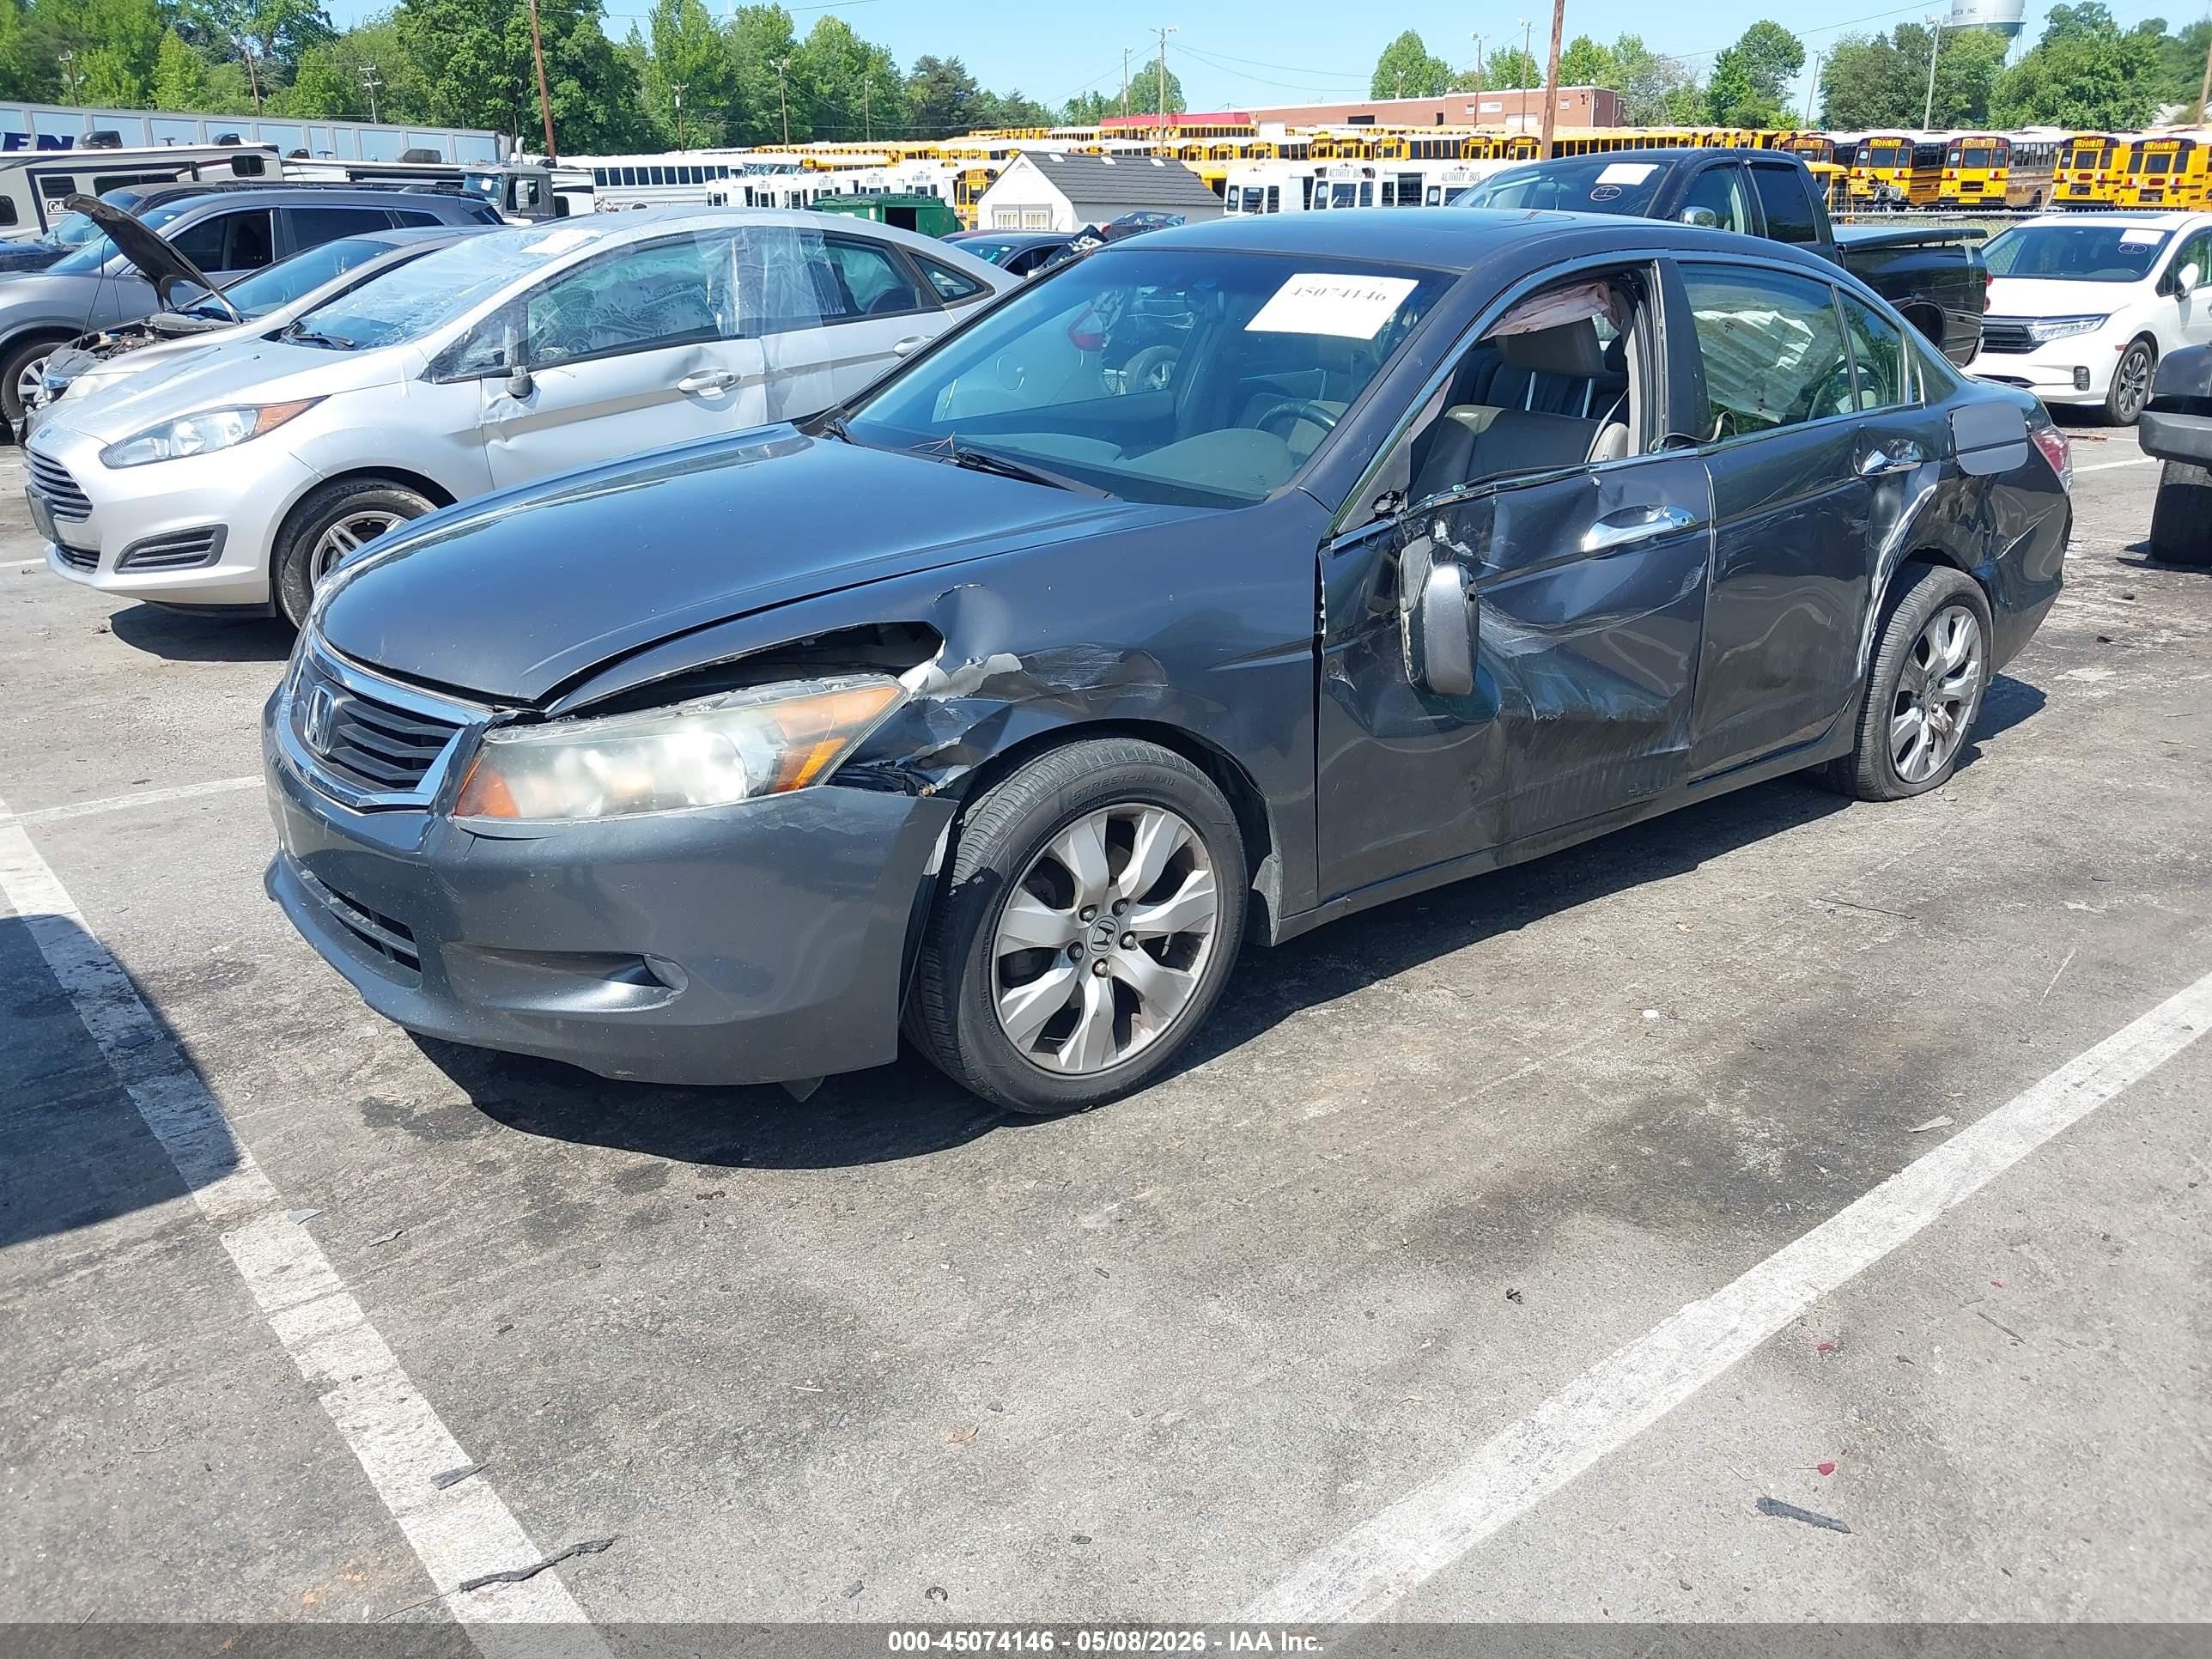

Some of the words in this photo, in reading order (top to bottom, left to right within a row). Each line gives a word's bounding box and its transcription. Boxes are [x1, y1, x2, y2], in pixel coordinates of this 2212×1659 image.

[1328, 168, 1350, 179] ACTIVITY
[1441, 171, 1466, 182] ACTIVITY
[1468, 171, 1480, 182] BUS
